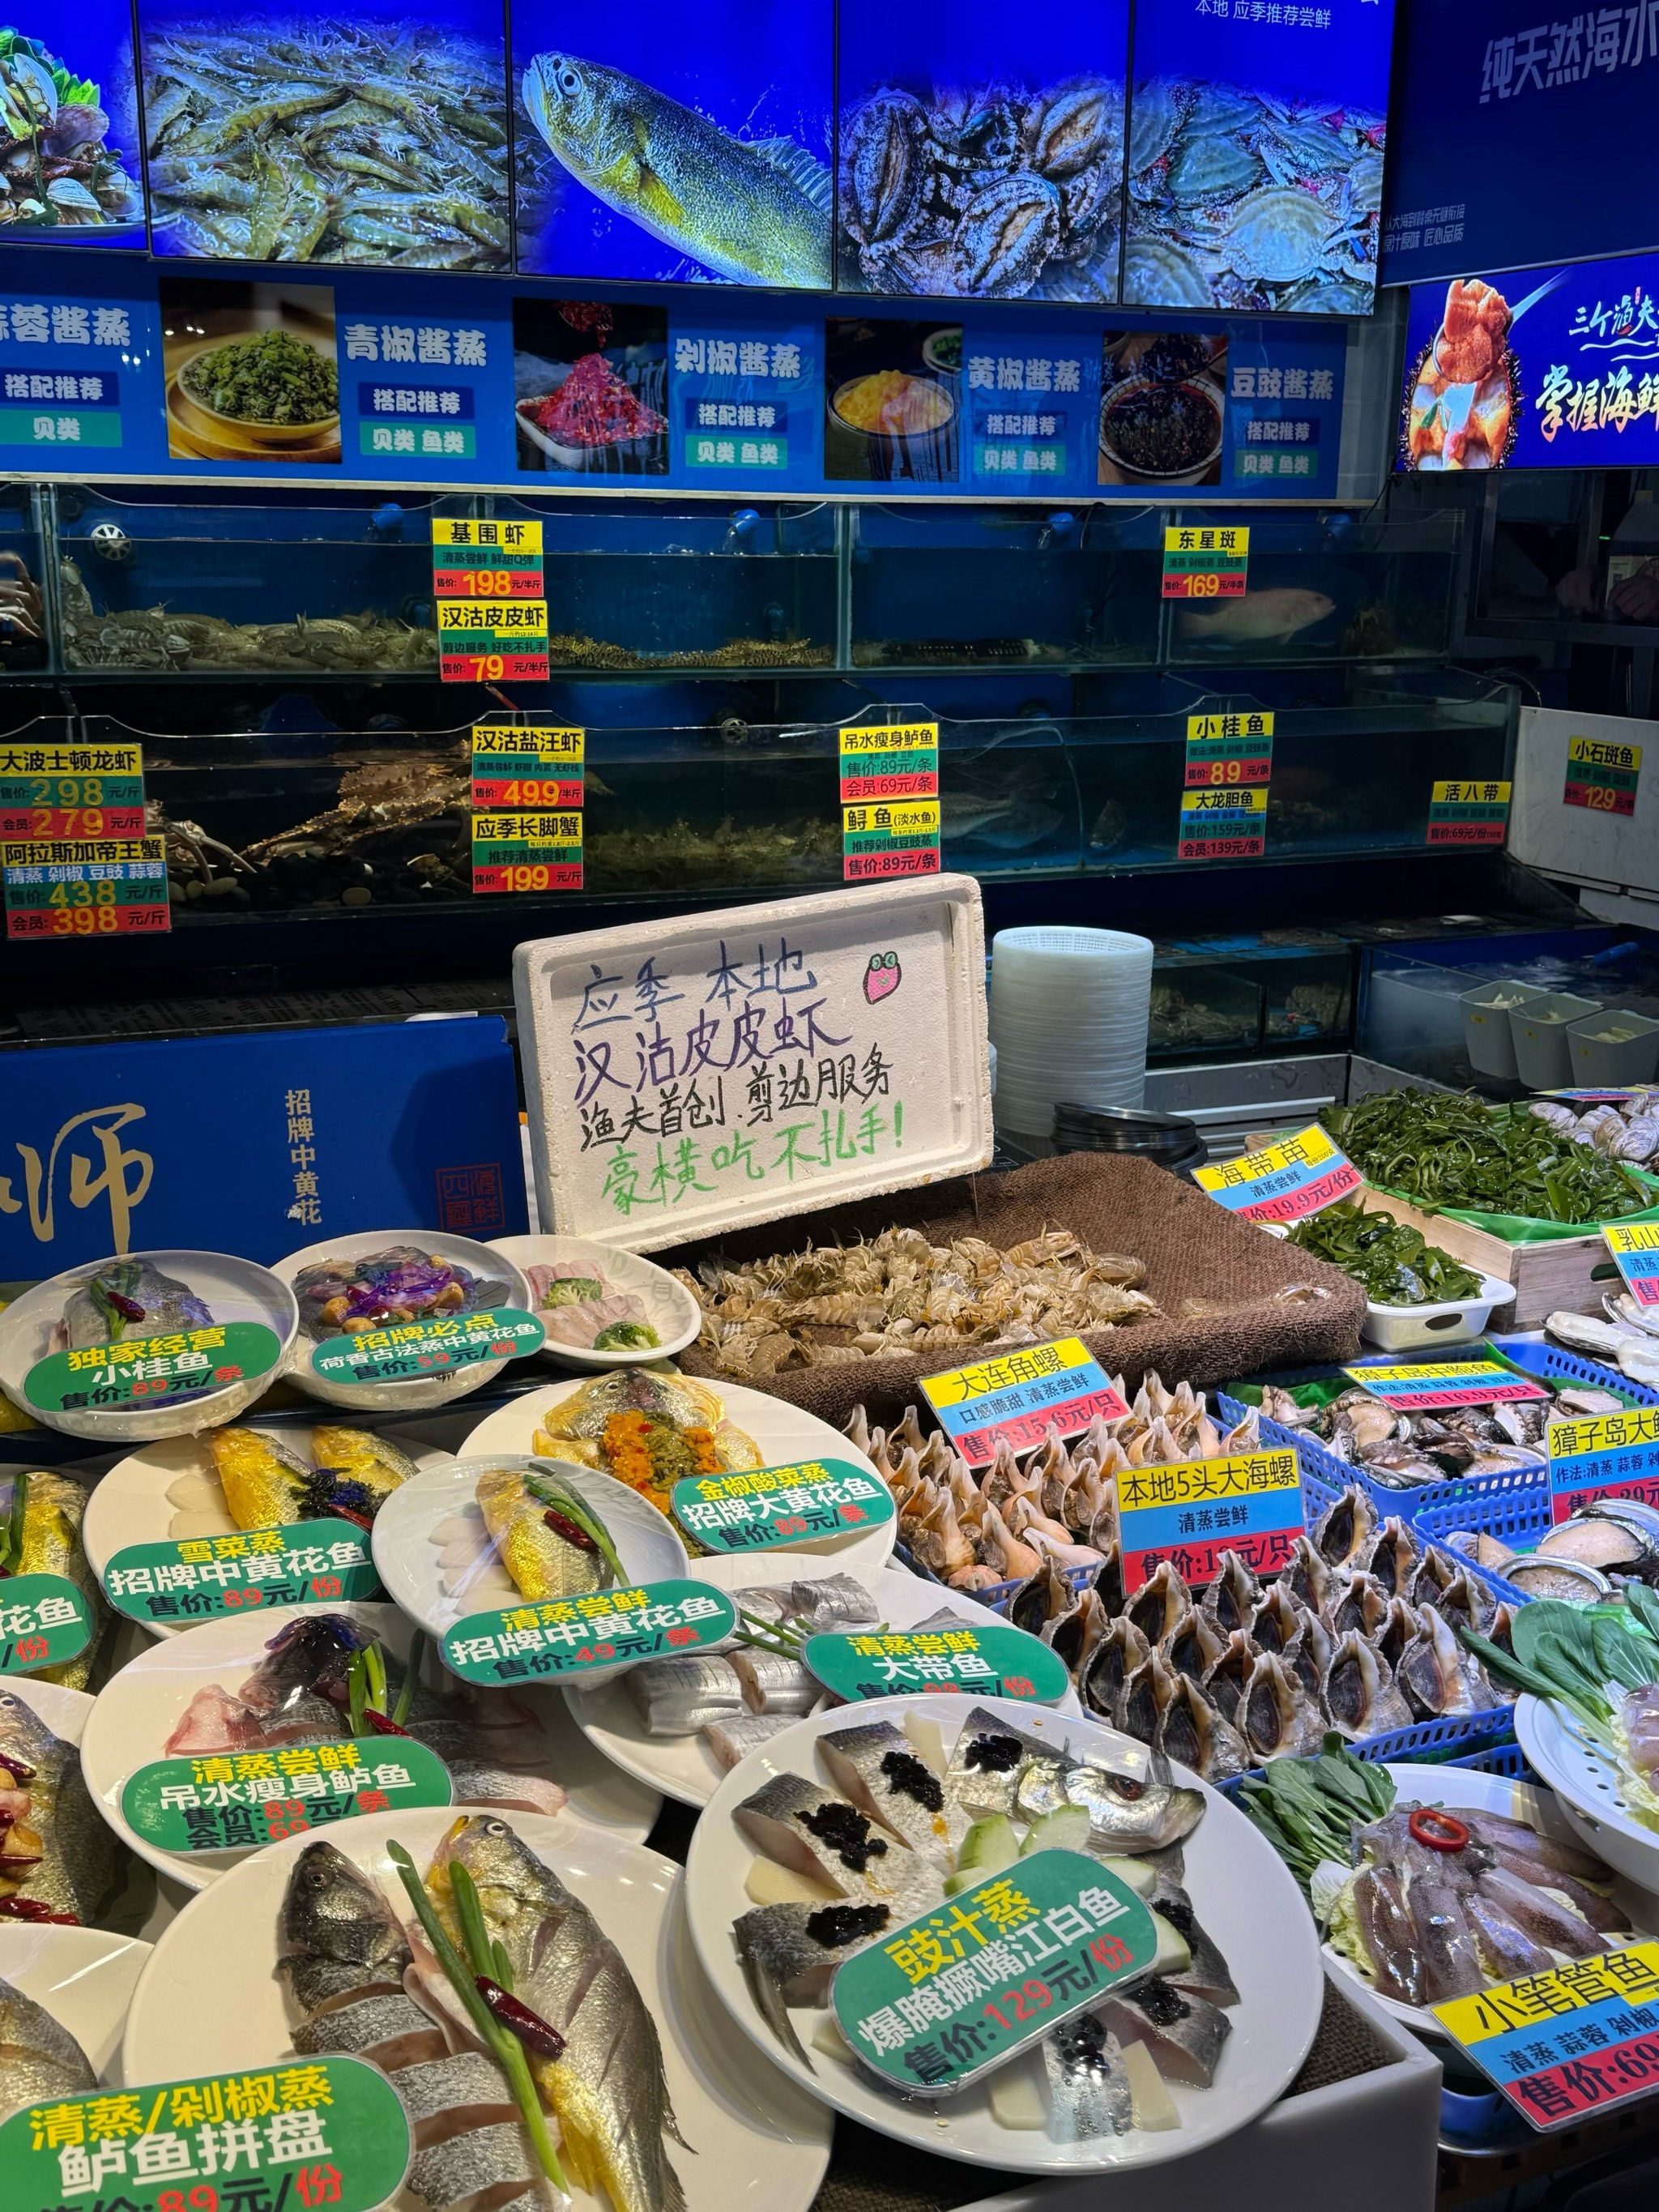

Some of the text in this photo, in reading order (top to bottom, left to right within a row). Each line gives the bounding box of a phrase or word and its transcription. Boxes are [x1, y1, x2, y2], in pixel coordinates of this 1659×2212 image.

[1196, 0, 1332, 30] 本地 应季推荐尝鲜
[1423, 223, 1465, 247] 匠心品质
[0, 304, 130, 347] 蓉酱蒸
[344, 323, 487, 366] 青椒酱蒸
[674, 338, 801, 378] 剁椒酱蒸
[5, 374, 104, 401] 搭配推荐
[967, 356, 1081, 393] 黄椒酱蒸
[1230, 367, 1334, 401] 豆豉酱蒸
[373, 388, 461, 415] 搭配推荐
[698, 403, 775, 429] 搭配推荐
[33, 416, 81, 442] 贝类
[373, 427, 464, 455] 贝类 鱼类
[987, 414, 1056, 436] 搭配推荐
[1247, 421, 1311, 442] 搭配推荐
[697, 440, 778, 466] 贝类 鱼类
[983, 450, 1056, 472] 贝类 鱼类
[1243, 455, 1310, 475] 贝类 鱼类
[450, 522, 526, 546] 基围虾
[1179, 530, 1236, 549] 东星斑
[442, 606, 544, 628] 汉沽皮皮虾
[491, 641, 546, 653] 好吃不扎手
[476, 730, 582, 753] 汉沽盐汪虾
[844, 728, 934, 750] 吊水瘦身鲈鱼
[1196, 714, 1265, 739] 小桂鱼
[1, 749, 137, 772] 大波士顿龙虾
[847, 757, 932, 779] 售价:89元/条
[1575, 740, 1634, 768] 小石斑鱼
[846, 775, 932, 797] 会员:69元/条
[1196, 791, 1254, 809] 大龙胆鱼
[1444, 784, 1499, 801] 活八带
[476, 816, 580, 839] 应季长脚蟹
[6, 839, 163, 865] 阿拉斯加帝王蟹
[488, 849, 569, 865] 推荐清蒸尝鲜
[851, 835, 932, 854] 推荐剁椒豆豉蒸
[6, 863, 163, 885] 清蒸 剁椒 豆豉 蒜蓉
[848, 852, 936, 876] 售价:89元/条
[570, 937, 818, 1035] 应季 本地
[574, 997, 854, 1108] 汉沽皮皮虾
[284, 1088, 322, 1226] 招牌中黄花
[1213, 1138, 1310, 1188] 海带苗
[0, 1102, 154, 1255] 师
[1249, 1170, 1303, 1198] 清蒸尝鲜
[1629, 1256, 1659, 1272] 清蒸
[67, 1326, 226, 1372] 独家经营
[319, 1322, 541, 1371] 荷香古法蒸中黄花鱼
[352, 1313, 500, 1353] 招牌必点
[92, 1352, 214, 1386] 小桂鱼
[952, 1346, 1068, 1401] 大连角螺
[958, 1372, 1090, 1425] 口感脆甜 清蒸尝鲜
[963, 1391, 1122, 1460] 售价:156元/只
[1617, 1453, 1644, 1473] 蒜蓉
[694, 1462, 834, 1501] 金椒酸菜蒸
[1121, 1454, 1297, 1508] 本地5头大海螺
[682, 1476, 884, 1531] 招牌大黄花鱼
[1178, 1504, 1249, 1535] 清蒸尝鲜
[177, 1531, 287, 1564] 雪菜蒸
[1141, 1534, 1292, 1579] 售价:1元/只
[108, 1540, 372, 1597] 招牌中黄花鱼
[145, 1574, 344, 1618] 售价:89元/份
[500, 1589, 652, 1633] 清蒸尝鲜
[449, 1595, 727, 1666] 招牌中黄花鱼
[846, 1630, 983, 1658] 清蒸尝鲜
[493, 1625, 702, 1680] 售价:49元/条
[872, 1652, 1000, 1681] 大带鱼
[190, 1742, 362, 1784] 清蒸尝鲜
[160, 1762, 416, 1811] 吊水瘦身鲈鱼
[181, 1790, 391, 1830] 售价:89元/条
[883, 1877, 1043, 1986] 豉汁蒸
[855, 1885, 1132, 2059] 爆腌撅嘴江白鱼
[903, 1932, 1135, 2084] 售价:129元/份
[1475, 1951, 1659, 2034] 小笔管鱼
[1499, 2040, 1559, 2074] 清蒸
[1553, 2022, 1610, 2055] 蒜蓉
[29, 2065, 335, 2152] 清蒸/剁椒蒸
[57, 2107, 333, 2198] 鲈鱼拼盘
